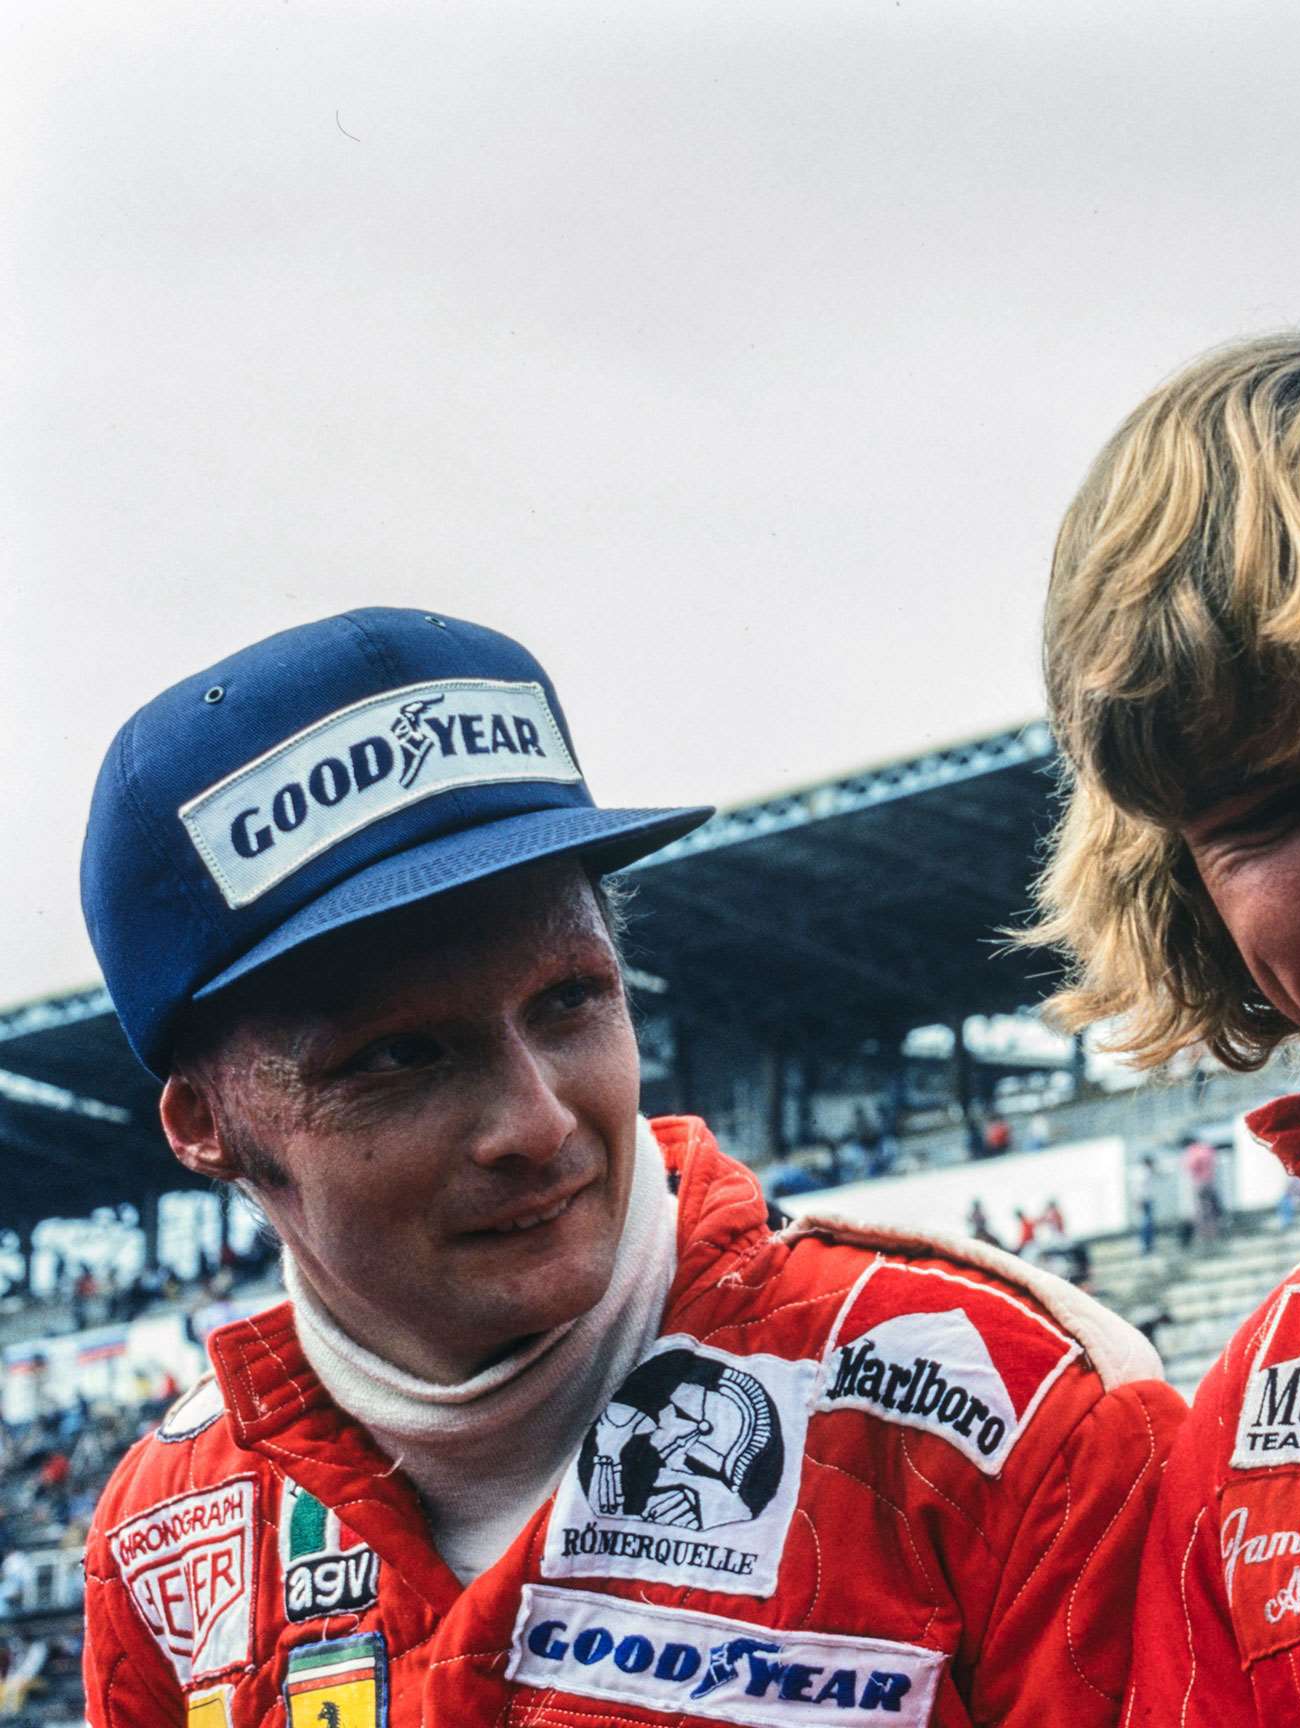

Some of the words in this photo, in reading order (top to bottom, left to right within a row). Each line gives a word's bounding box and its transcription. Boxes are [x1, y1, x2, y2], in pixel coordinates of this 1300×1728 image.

[826, 1337, 1006, 1456] Marlboro
[561, 1521, 758, 1576] RÖMERQUELLE
[288, 1551, 371, 1612] agv
